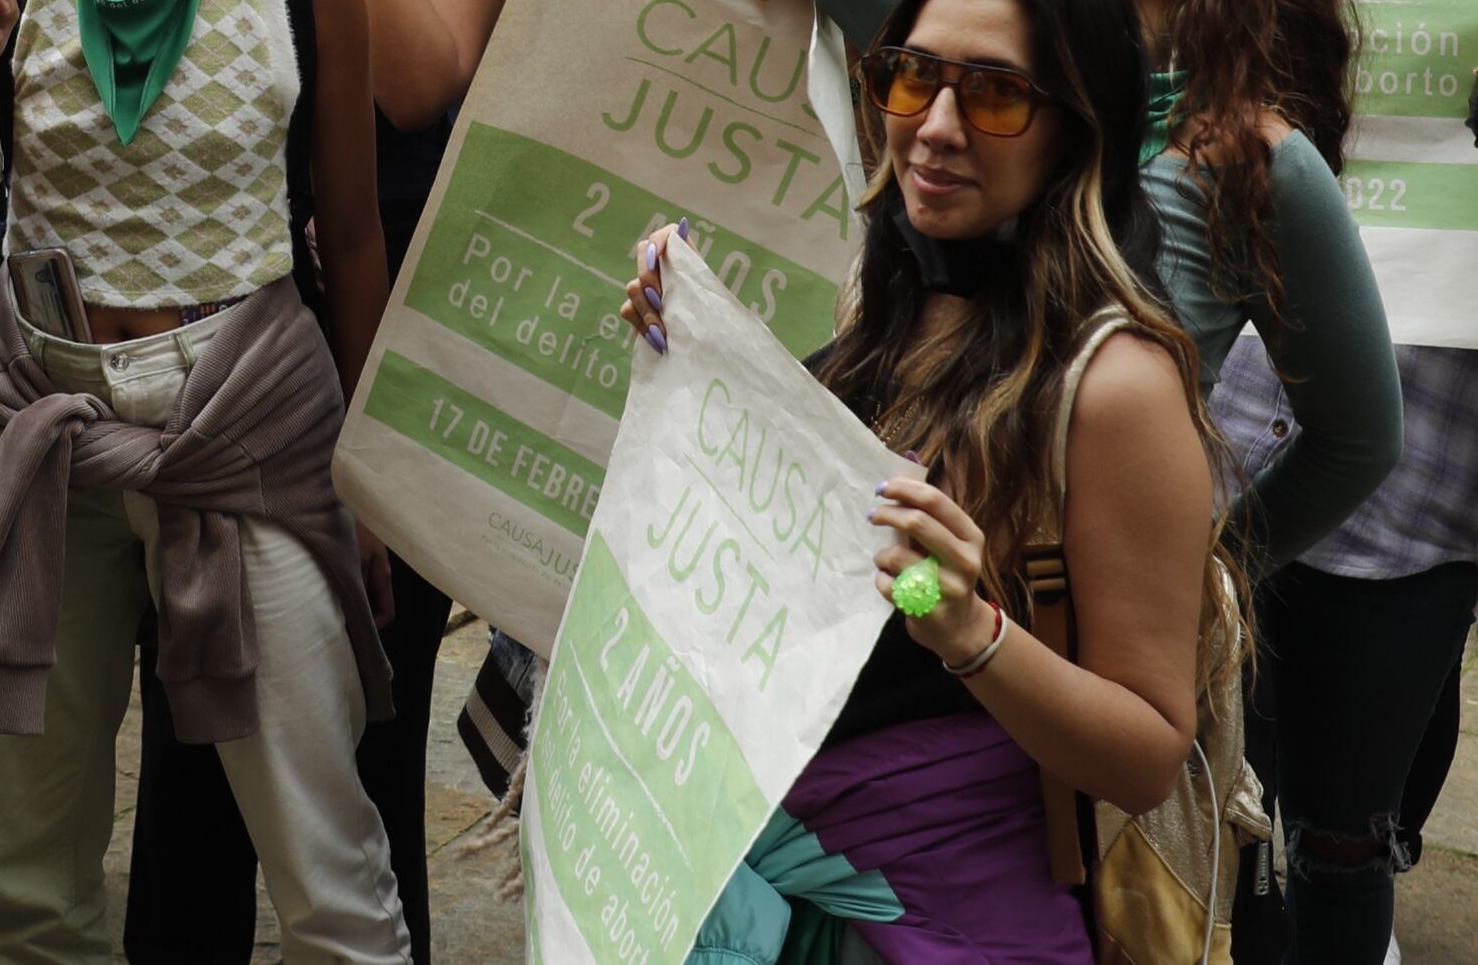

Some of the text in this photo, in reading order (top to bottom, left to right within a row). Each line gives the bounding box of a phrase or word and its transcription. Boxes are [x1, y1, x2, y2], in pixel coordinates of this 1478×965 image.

[1355, 67, 1460, 97] borto
[572, 181, 611, 239] 2
[602, 78, 850, 241] JUSTA
[1345, 177, 1408, 212] 022
[448, 279, 506, 326] del
[515, 315, 620, 389] delito
[463, 233, 582, 321] Por la
[429, 398, 602, 521] 17 DE FEBRE
[698, 378, 826, 583] CAUSA
[647, 485, 788, 693] JUSTA
[599, 608, 711, 787] 2 AÑOS
[547, 769, 577, 851] delito
[575, 845, 601, 895] de
[601, 893, 650, 965] abort
[554, 670, 680, 953] Por la eliminación
